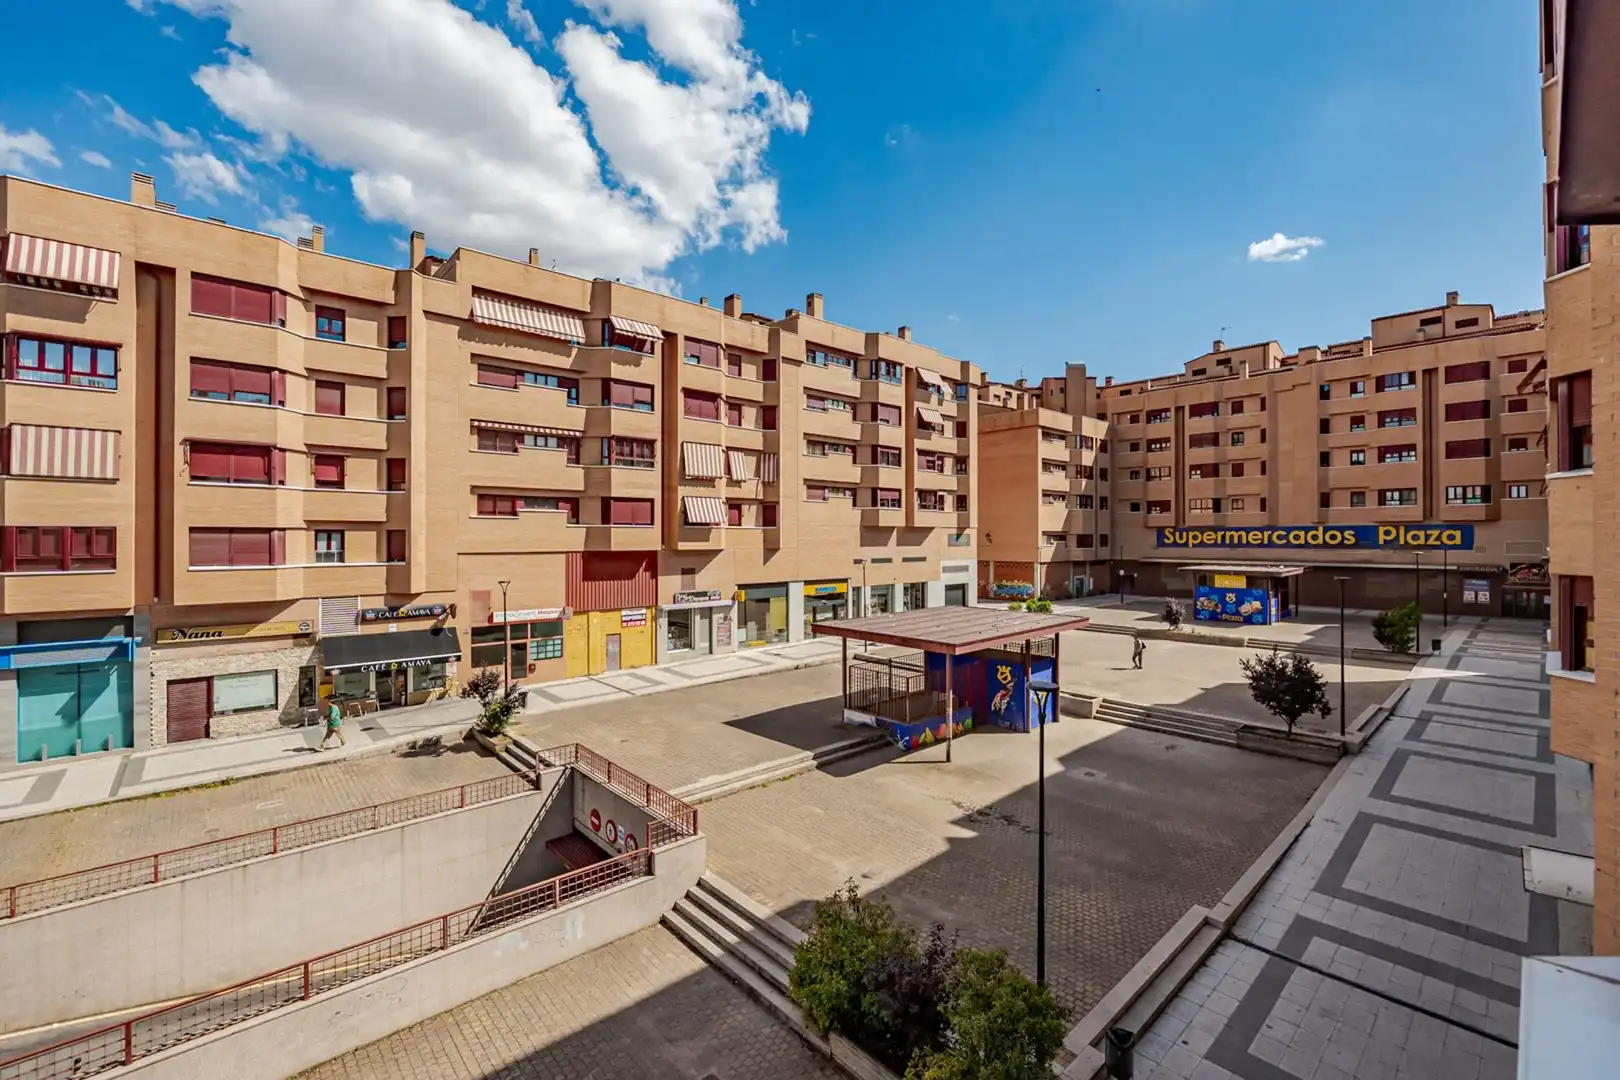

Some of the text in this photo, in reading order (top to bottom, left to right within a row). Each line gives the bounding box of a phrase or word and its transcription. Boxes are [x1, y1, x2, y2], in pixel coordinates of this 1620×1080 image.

[1163, 525, 1462, 548] Supermercados Plaza
[407, 609, 431, 617] AMAYA
[172, 627, 224, 640] Nana
[401, 659, 432, 669] AMAYA
